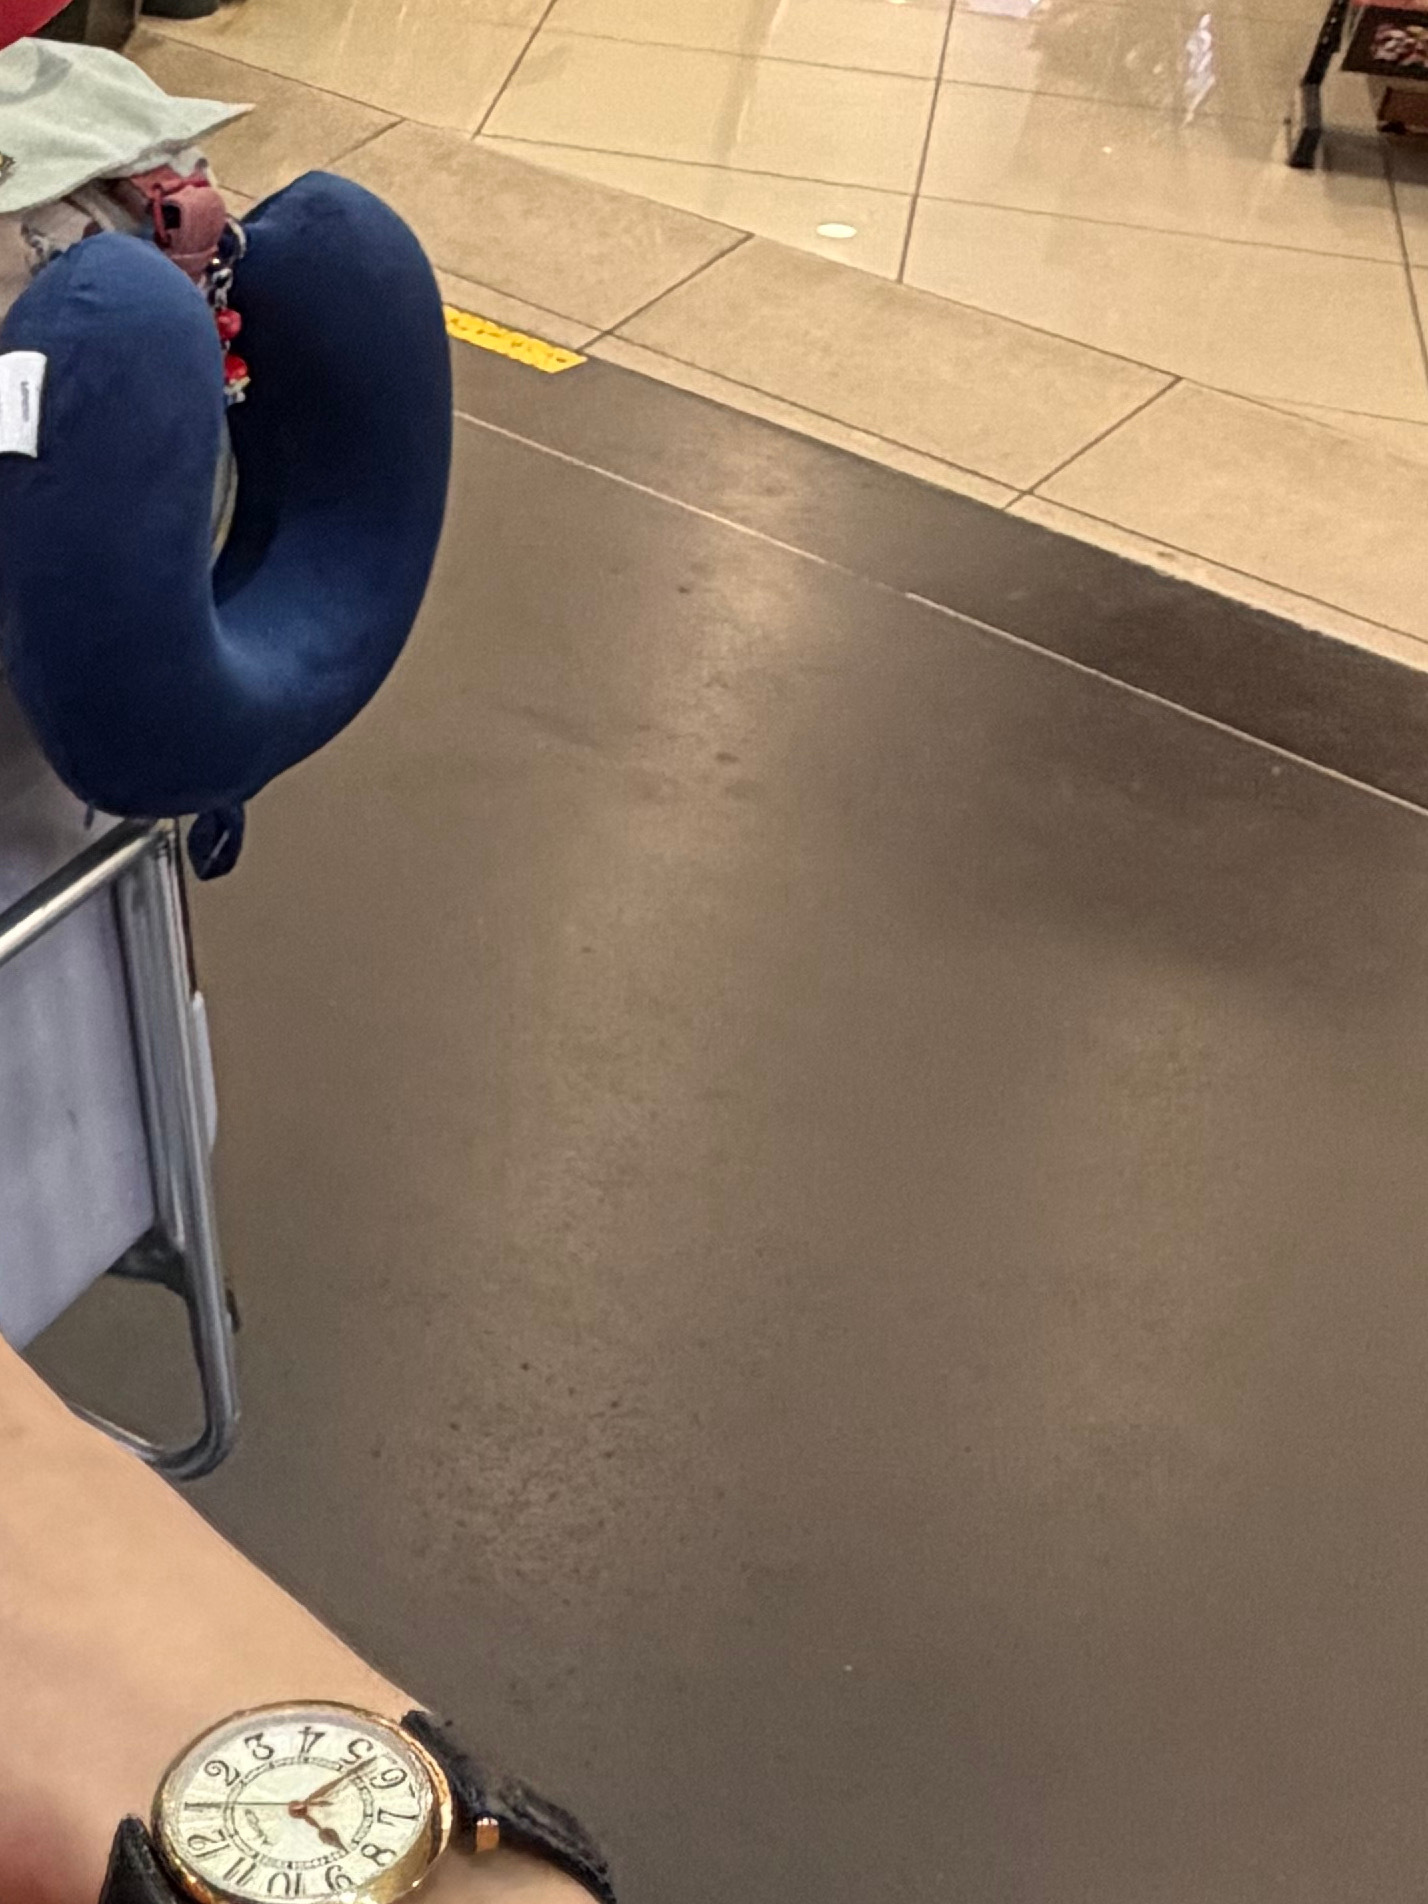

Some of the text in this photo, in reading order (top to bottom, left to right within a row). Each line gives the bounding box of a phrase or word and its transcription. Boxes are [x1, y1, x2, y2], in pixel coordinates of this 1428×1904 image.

[244, 1732, 275, 1760] 3
[298, 1726, 325, 1757] 4
[341, 1738, 374, 1765] 5
[204, 1760, 242, 1787] 2
[184, 1800, 222, 1812] 1
[186, 1828, 231, 1859] 12
[222, 1856, 258, 1887] 11
[266, 1871, 307, 1897] 10
